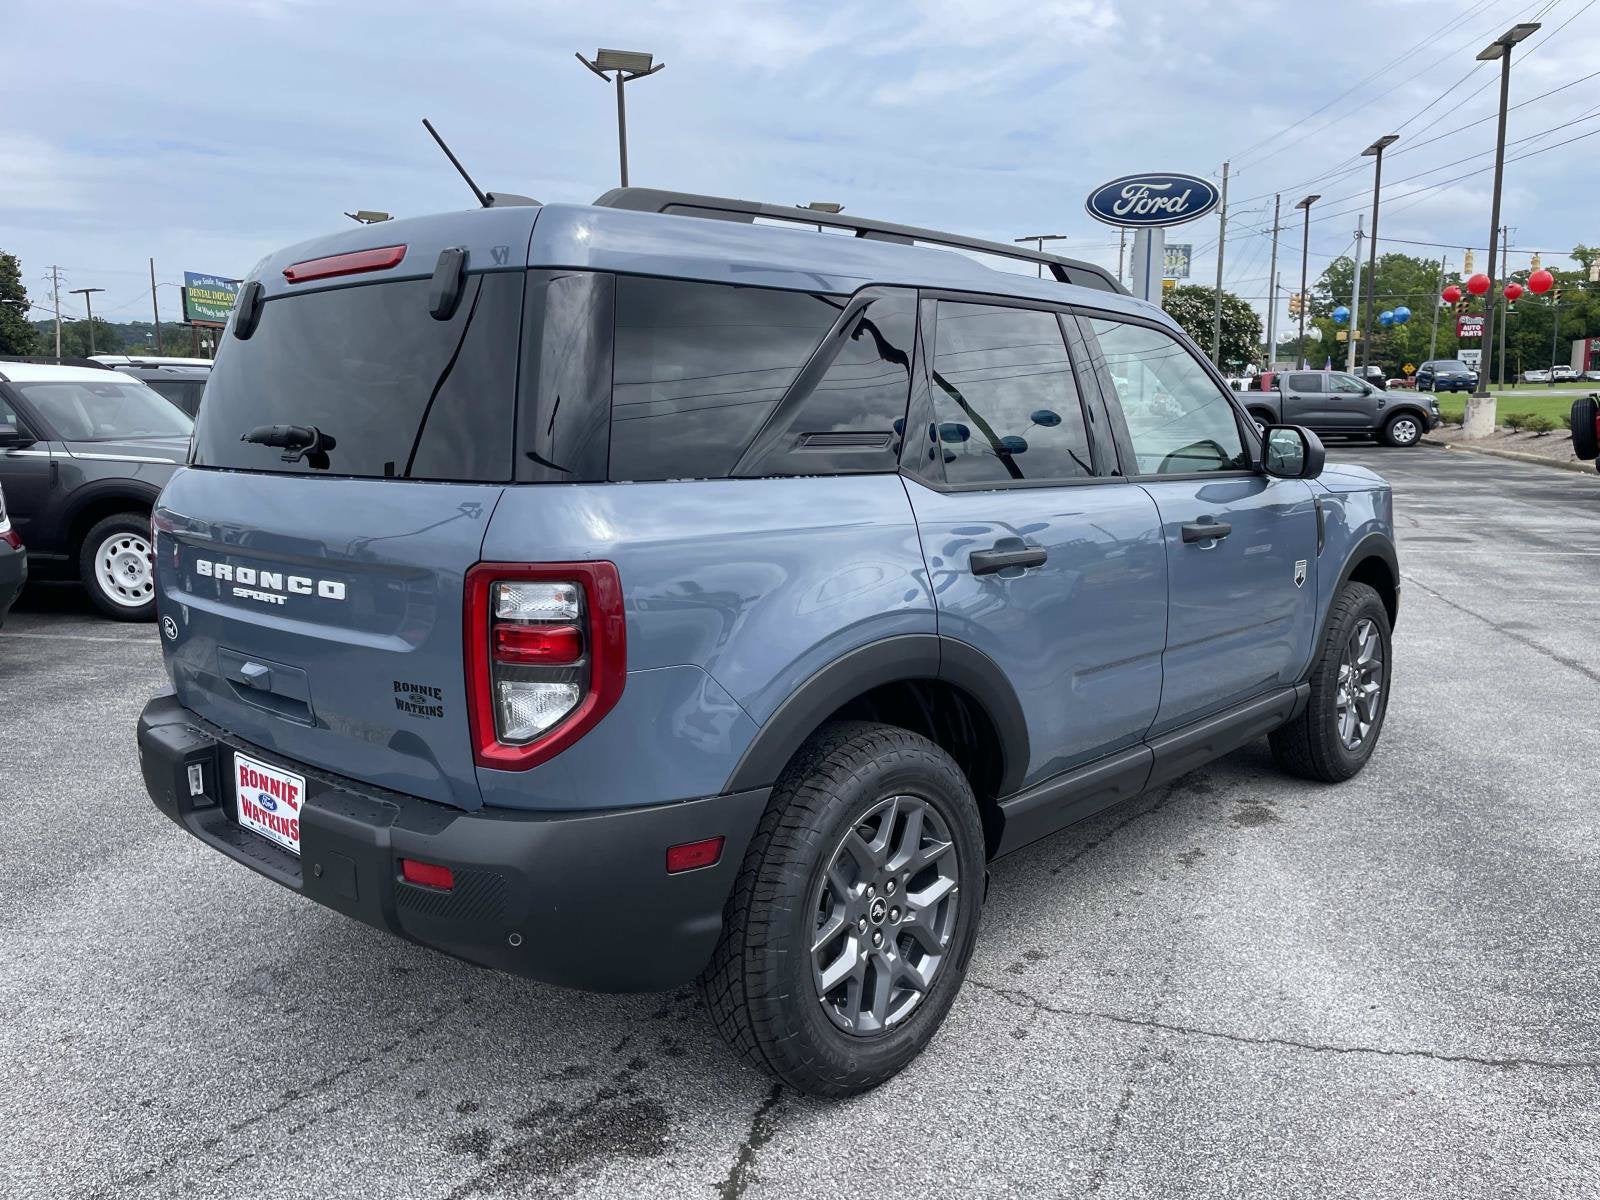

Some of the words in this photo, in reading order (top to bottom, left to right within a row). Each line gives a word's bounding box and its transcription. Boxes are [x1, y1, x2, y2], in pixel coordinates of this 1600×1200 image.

[1113, 183, 1192, 215] Ford
[189, 288, 211, 299] DENTAL
[196, 559, 346, 600] BRONCO
[232, 587, 288, 605] SPORT
[393, 680, 442, 701] RONNIE
[395, 696, 444, 718] WATKINS
[239, 764, 298, 812] RONNIE
[241, 793, 299, 842] WATKINS
